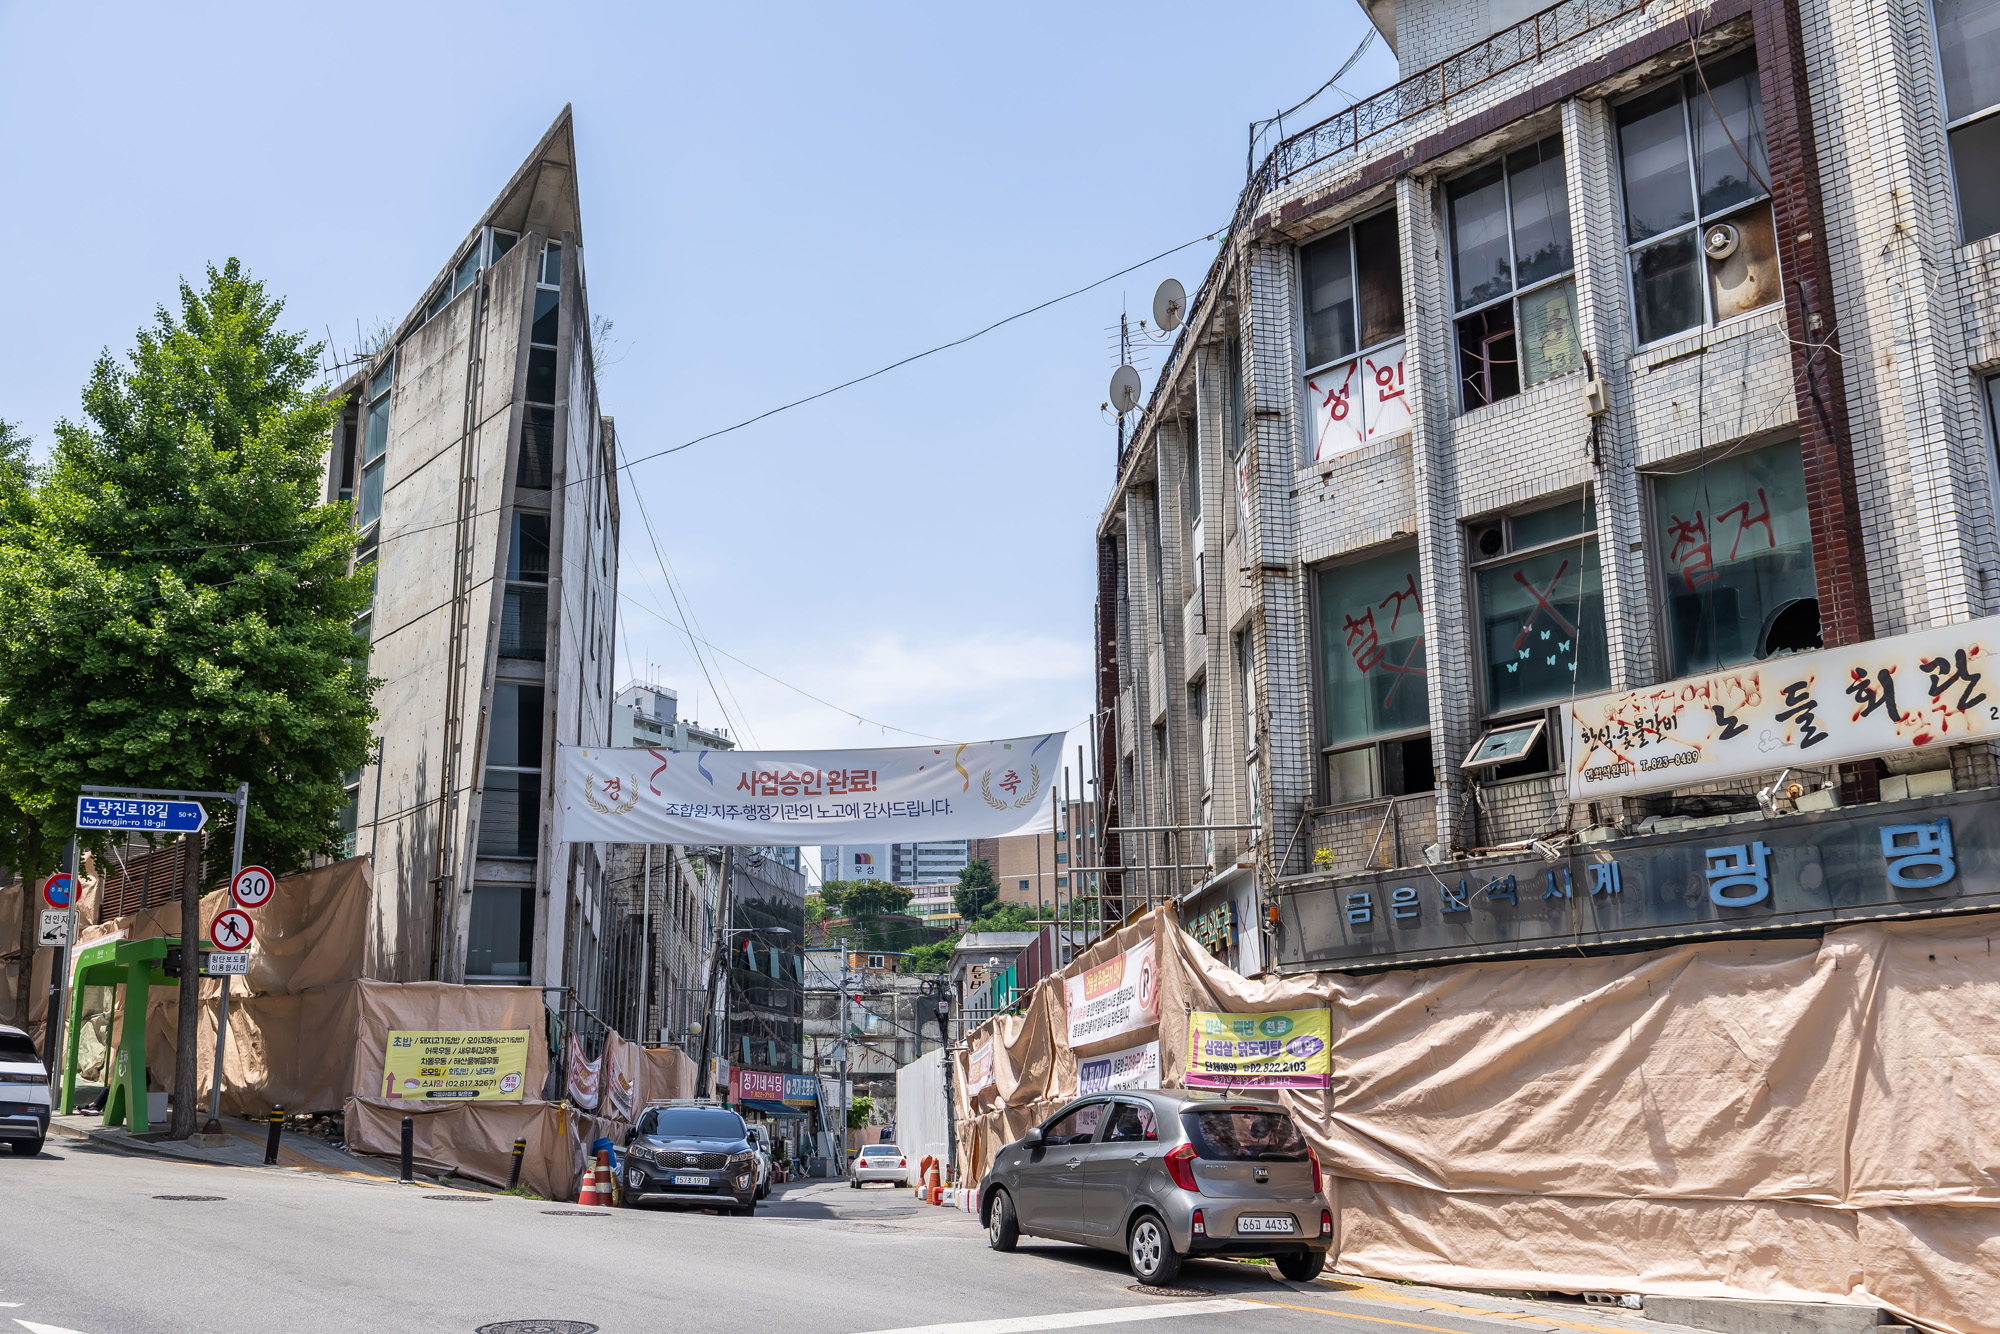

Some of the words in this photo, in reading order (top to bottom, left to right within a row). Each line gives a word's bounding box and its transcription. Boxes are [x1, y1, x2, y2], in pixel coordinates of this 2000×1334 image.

[1323, 361, 1404, 421] 성인
[1668, 487, 1776, 595] 철거
[1342, 572, 1423, 673] 철거
[1581, 713, 1679, 752] 한식·숯불갈비
[1640, 750, 1699, 772] T.823-8489
[1584, 763, 1630, 782] 연회석완비
[602, 777, 622, 801] 경
[736, 770, 822, 797] 사업승인
[826, 769, 877, 795] 완료!
[999, 769, 1022, 796] 축
[82, 801, 168, 819] 노량진로18길
[666, 802, 813, 821] 조합원·지주·행정기관의
[816, 802, 860, 819] 노고에
[862, 798, 953, 819] 감사드립니다.
[82, 816, 140, 826] Noryangjin-ro
[143, 819, 166, 828] 18-gil
[855, 866, 874, 875] 우성
[240, 877, 266, 897] 30
[211, 955, 246, 963] 횡단보도를
[211, 964, 246, 972] 이용합시다
[1205, 1019, 1223, 1036] 한식
[1232, 1019, 1256, 1036] 백반
[1265, 1020, 1288, 1033] 전문
[393, 1036, 413, 1047] 초밥
[419, 1036, 460, 1045] 돼지고기덮밥
[424, 1047, 451, 1055] 어묵우동
[457, 1046, 498, 1055] 새우튀김우동
[1204, 1040, 1283, 1057] 삼겹살·닭도리탕
[1291, 1038, 1316, 1054] 예약
[420, 1058, 448, 1066] 차돌우동
[1204, 1061, 1238, 1073] 단체예약
[1250, 1061, 1307, 1073] 02.822.2103
[421, 1068, 441, 1076] 온모밀
[448, 1067, 469, 1075] 회덮밥
[475, 1067, 496, 1075] 냉모밀
[743, 1073, 782, 1092] 정가네식당
[1258, 1168, 1269, 1176] KIA
[1264, 1220, 1289, 1230] 4433
